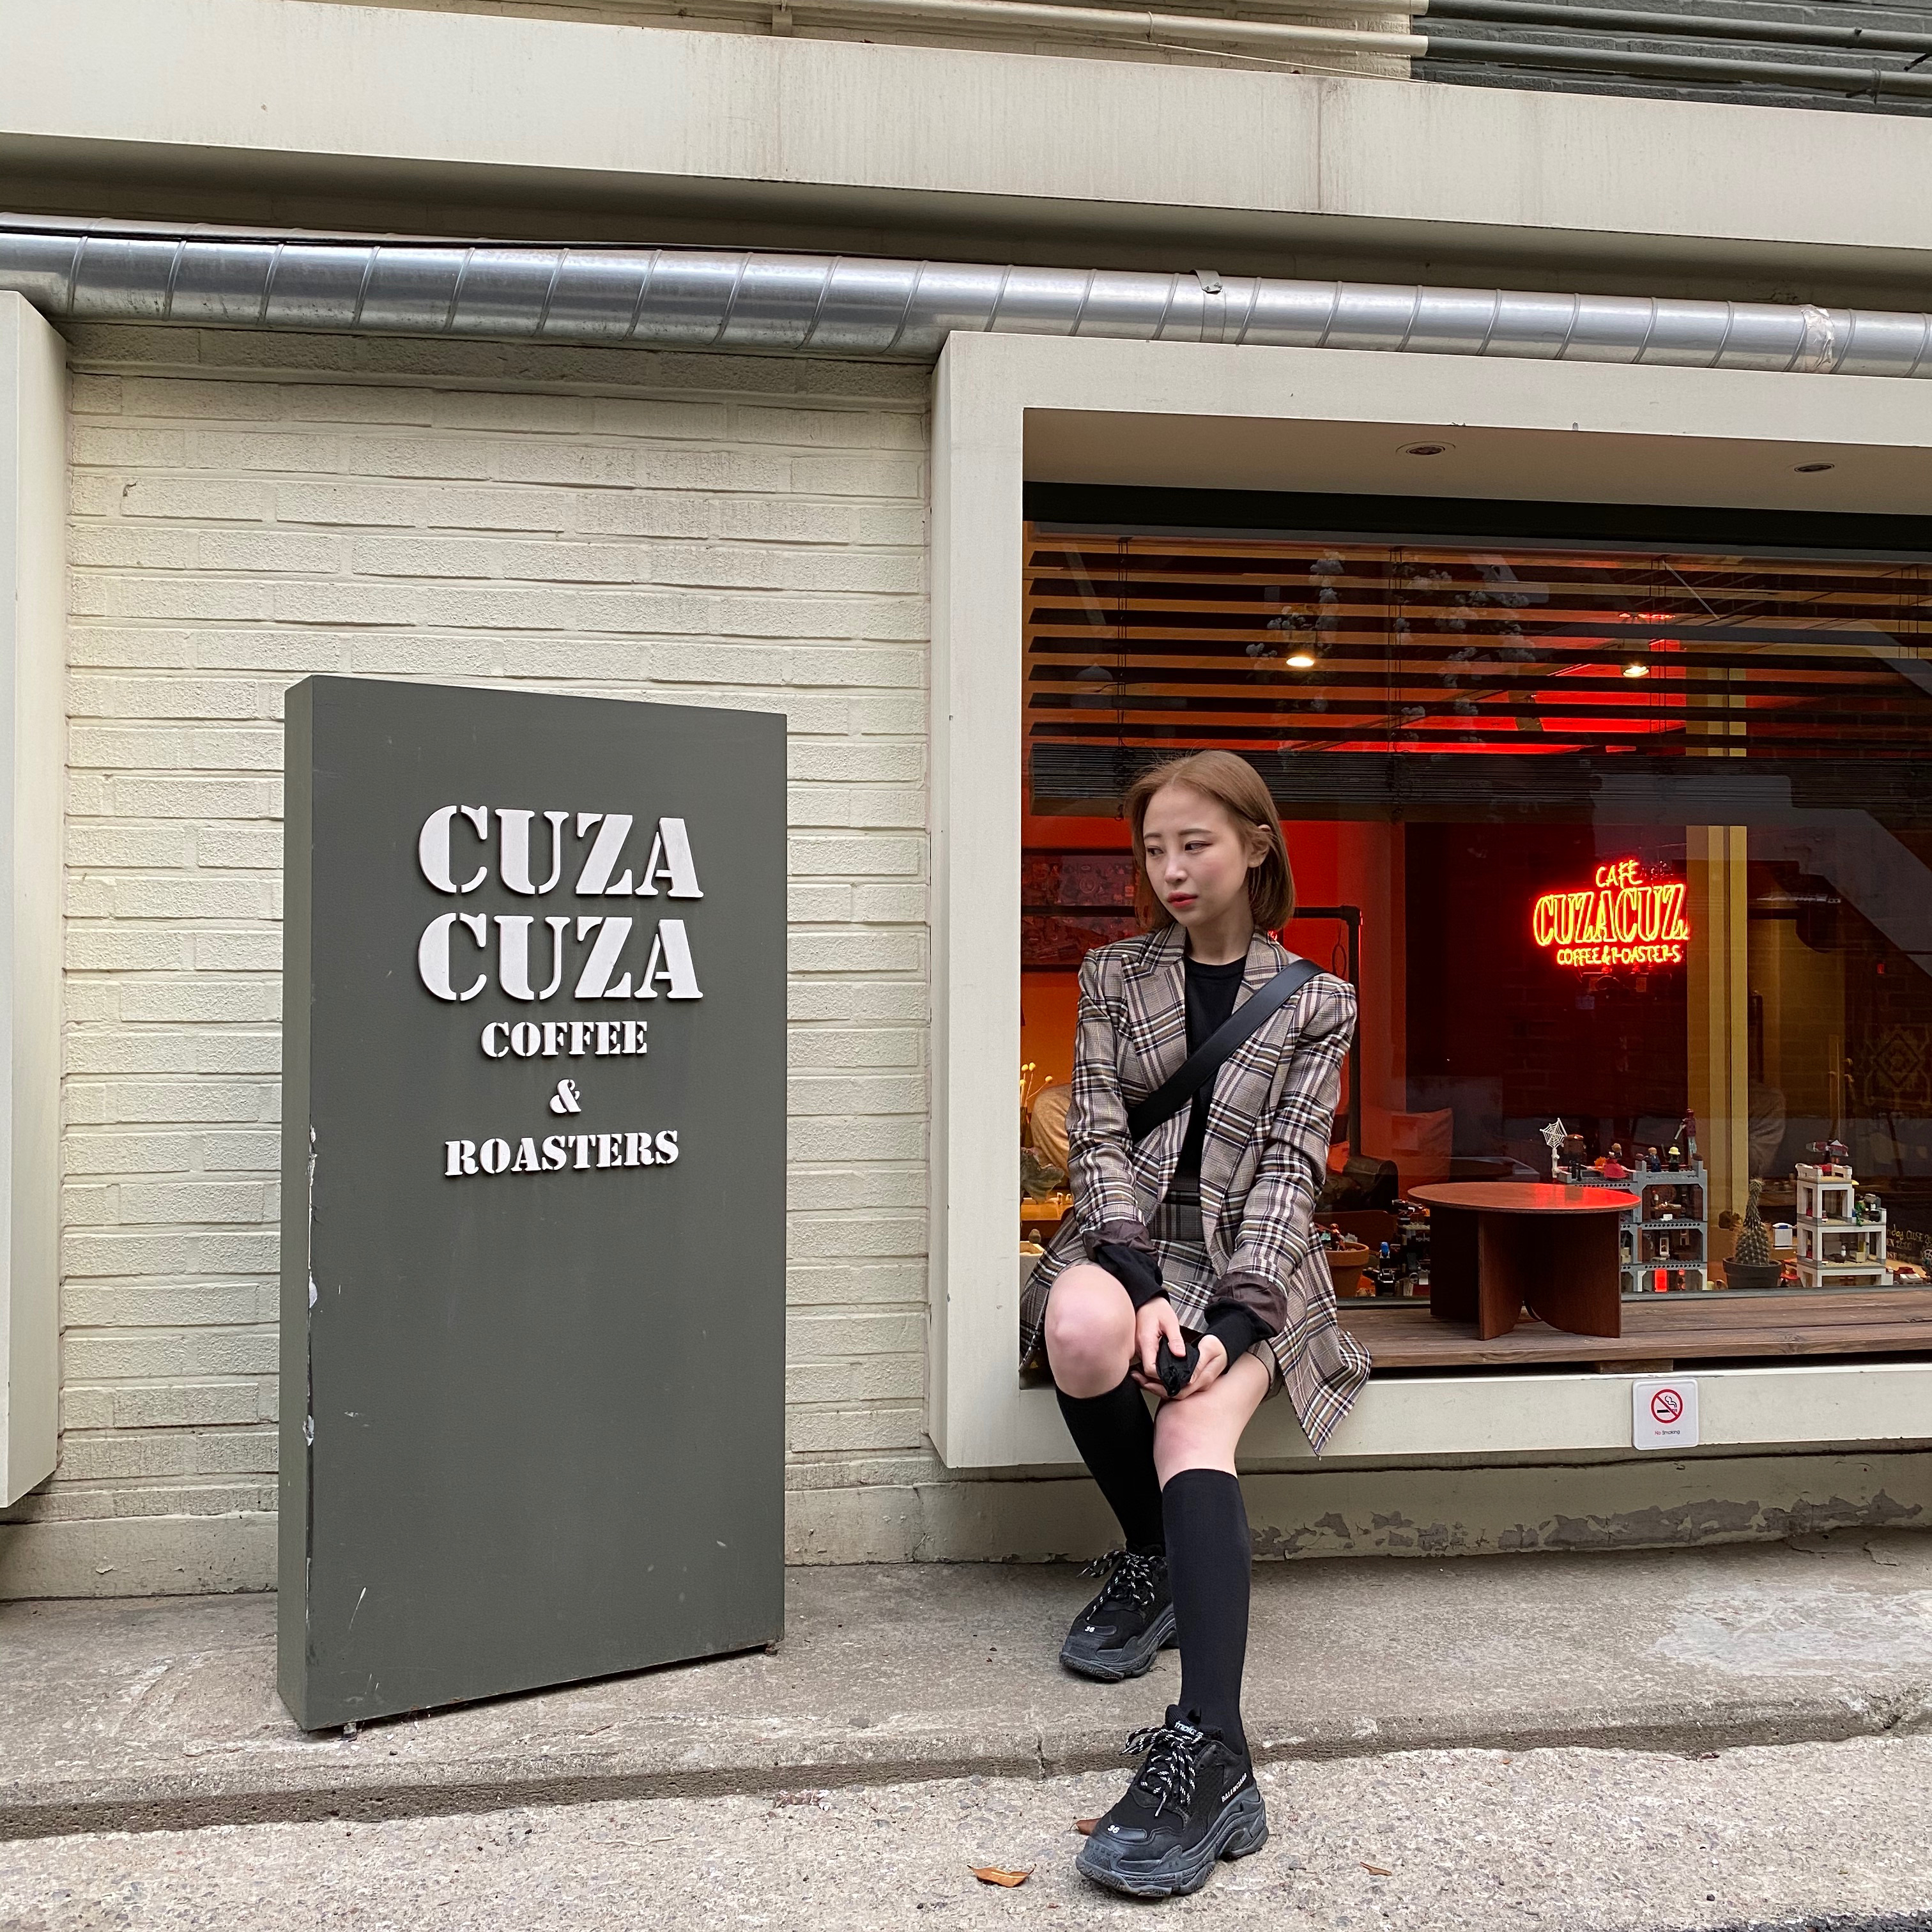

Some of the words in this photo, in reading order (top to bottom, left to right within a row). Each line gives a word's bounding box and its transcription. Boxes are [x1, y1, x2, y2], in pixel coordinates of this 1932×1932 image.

[418, 804, 704, 898] CUZA
[1533, 883, 1689, 946] CUZACUZ
[418, 912, 703, 1001] CUZA
[480, 1020, 648, 1057] COFFEE
[549, 1078, 581, 1114] &
[444, 1130, 679, 1176] ROASTERS
